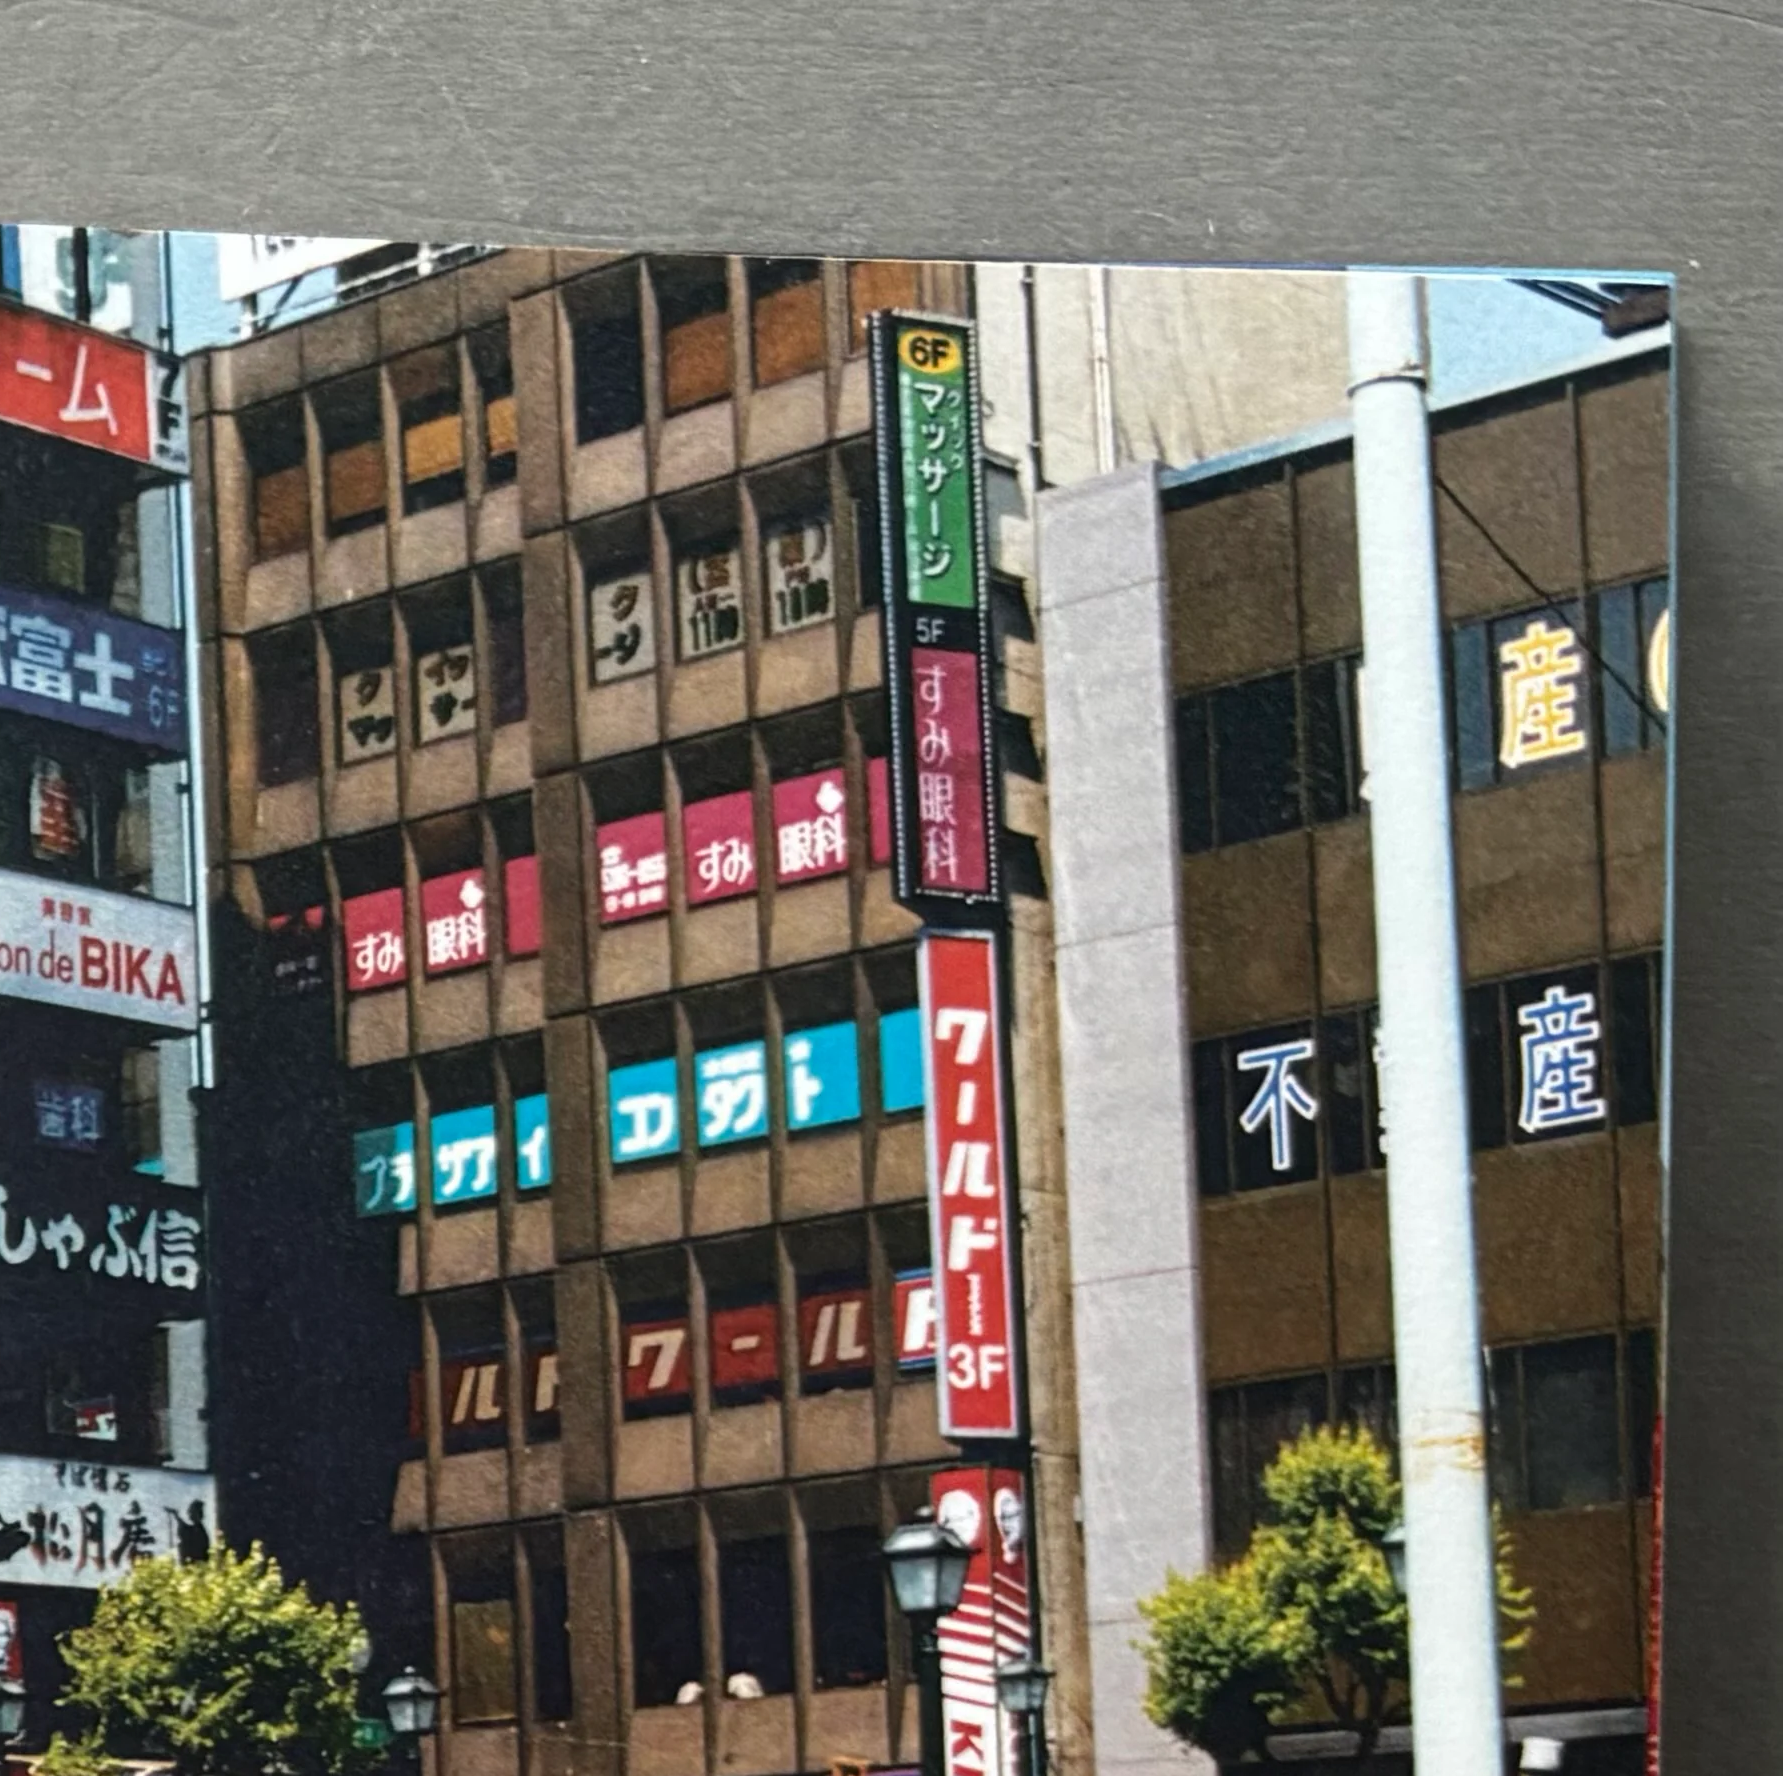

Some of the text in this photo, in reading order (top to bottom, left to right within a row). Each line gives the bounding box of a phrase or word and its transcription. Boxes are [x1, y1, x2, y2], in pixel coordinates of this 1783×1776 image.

[909, 335, 950, 368] 6F
[913, 381, 952, 578] マッサージ
[916, 618, 945, 644] 5F
[914, 665, 960, 884] すみ眼科
[37, 929, 75, 983] de
[81, 935, 186, 1005] BIKA
[935, 1008, 999, 1273] ワールド
[948, 1342, 1006, 1390] 3F
